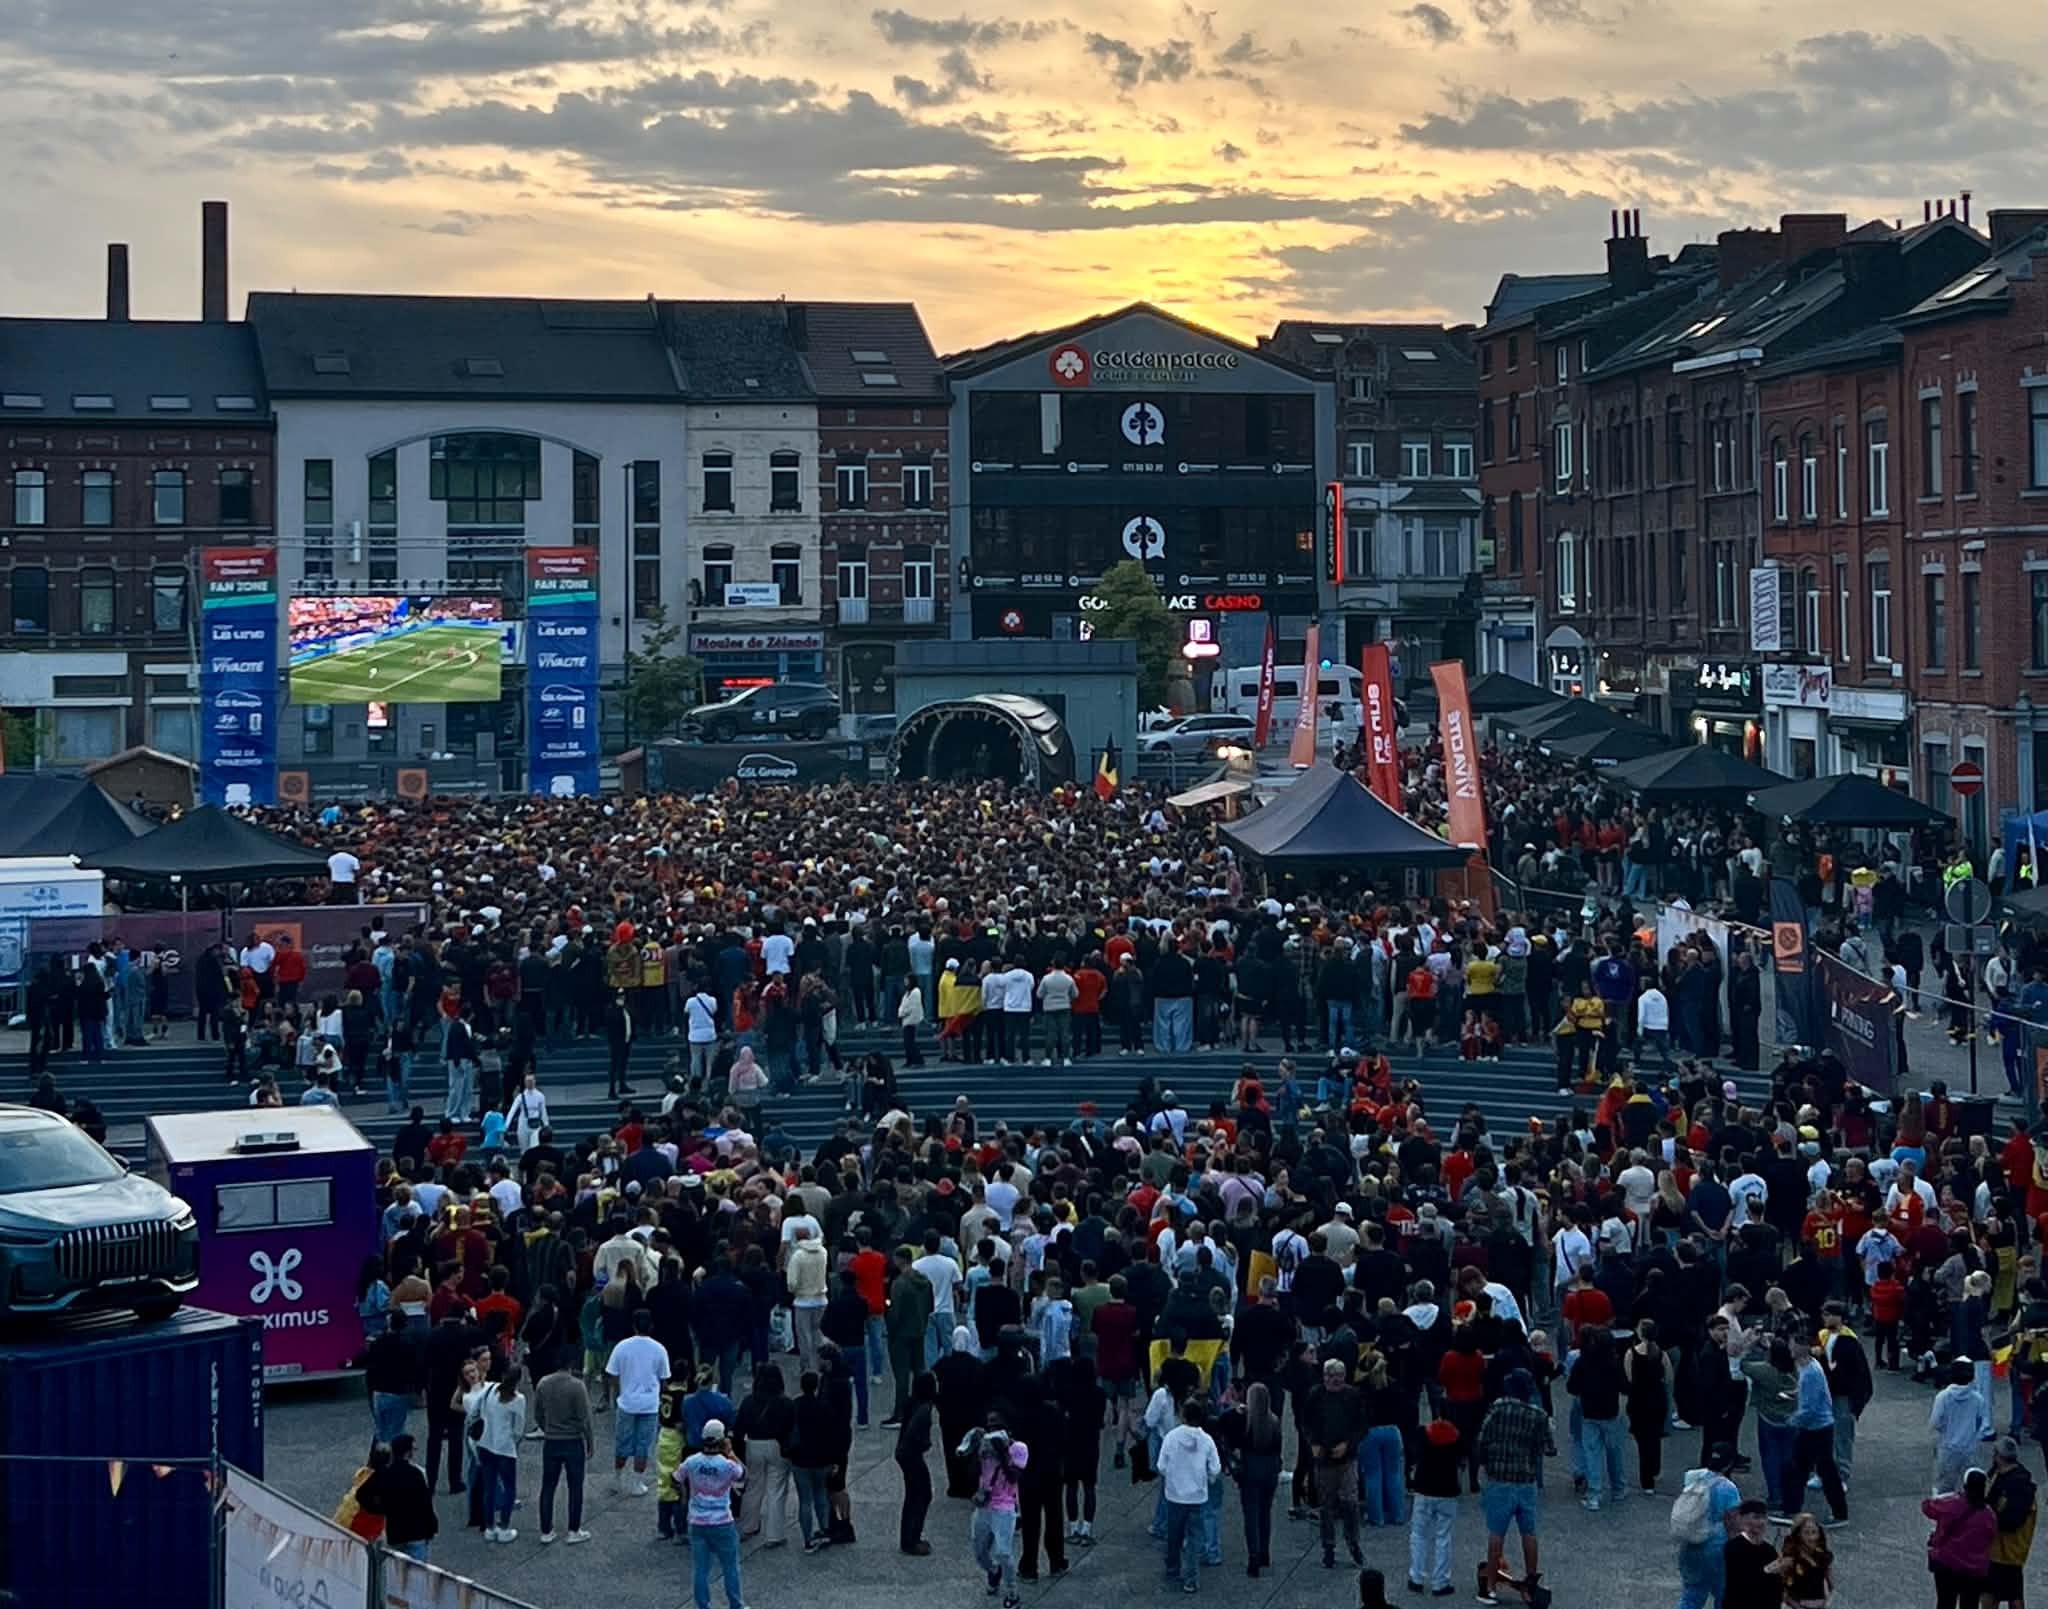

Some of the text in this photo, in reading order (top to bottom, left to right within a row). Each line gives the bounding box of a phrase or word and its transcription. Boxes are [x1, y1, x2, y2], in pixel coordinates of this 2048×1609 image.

[1094, 350, 1239, 371] Goldenpalace
[210, 581, 268, 592] FAN ZONE
[535, 579, 588, 589] FAN ZONE
[1204, 596, 1261, 610] CASINO
[697, 638, 743, 649] Moules
[747, 637, 763, 648] de
[1815, 1227, 1836, 1249] 10
[263, 1308, 329, 1329] ximus
